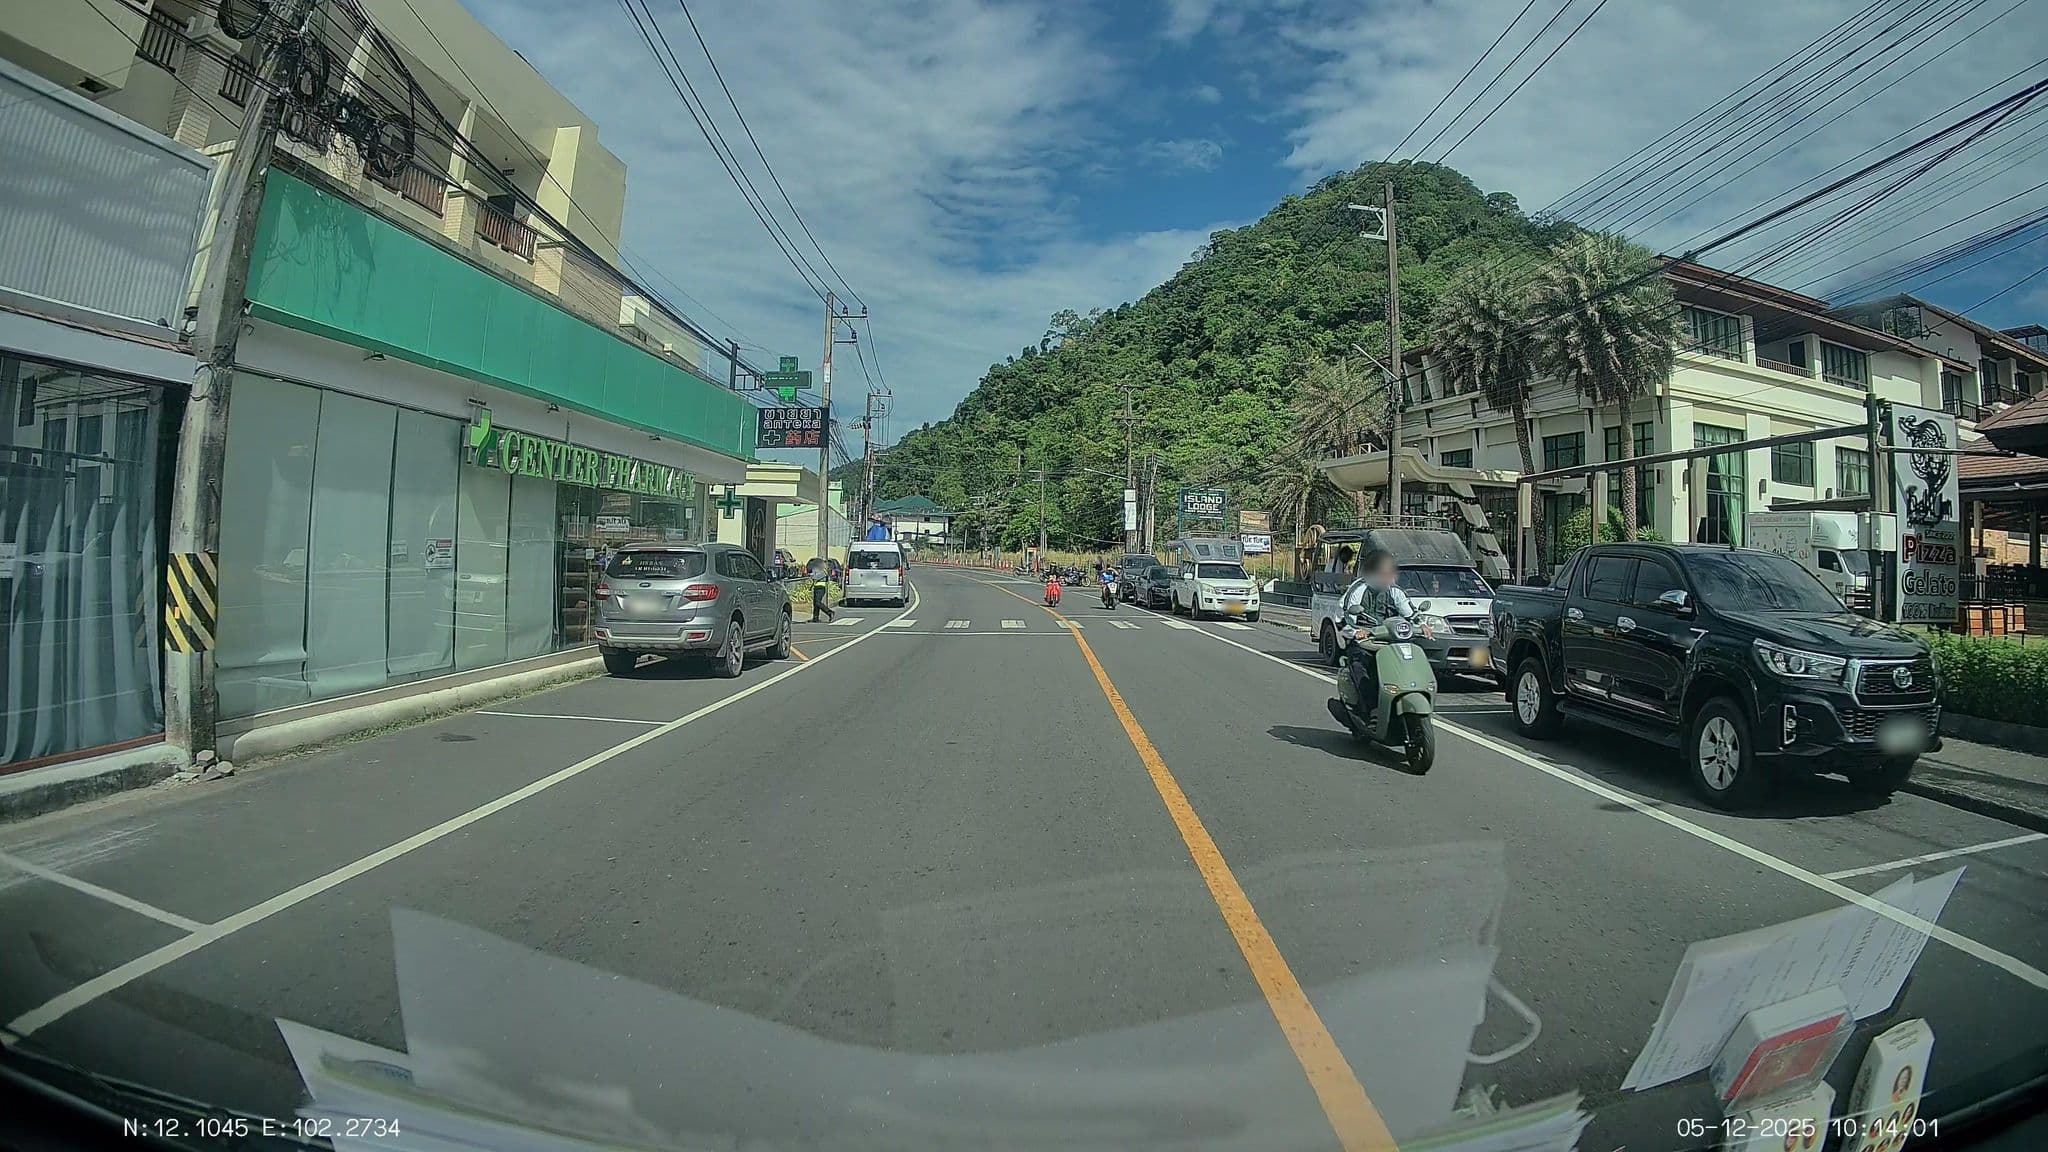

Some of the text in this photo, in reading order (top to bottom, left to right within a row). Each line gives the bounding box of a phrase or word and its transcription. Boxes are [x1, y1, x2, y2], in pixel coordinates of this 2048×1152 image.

[764, 408, 822, 420] ขายยา
[763, 420, 821, 430] аптека
[502, 431, 696, 501] CENTER PHARMACY
[1184, 495, 1223, 504] ISLAND
[1187, 503, 1219, 511] LODGE
[1903, 532, 1957, 565] Pizza
[1902, 568, 1957, 596] Gelato
